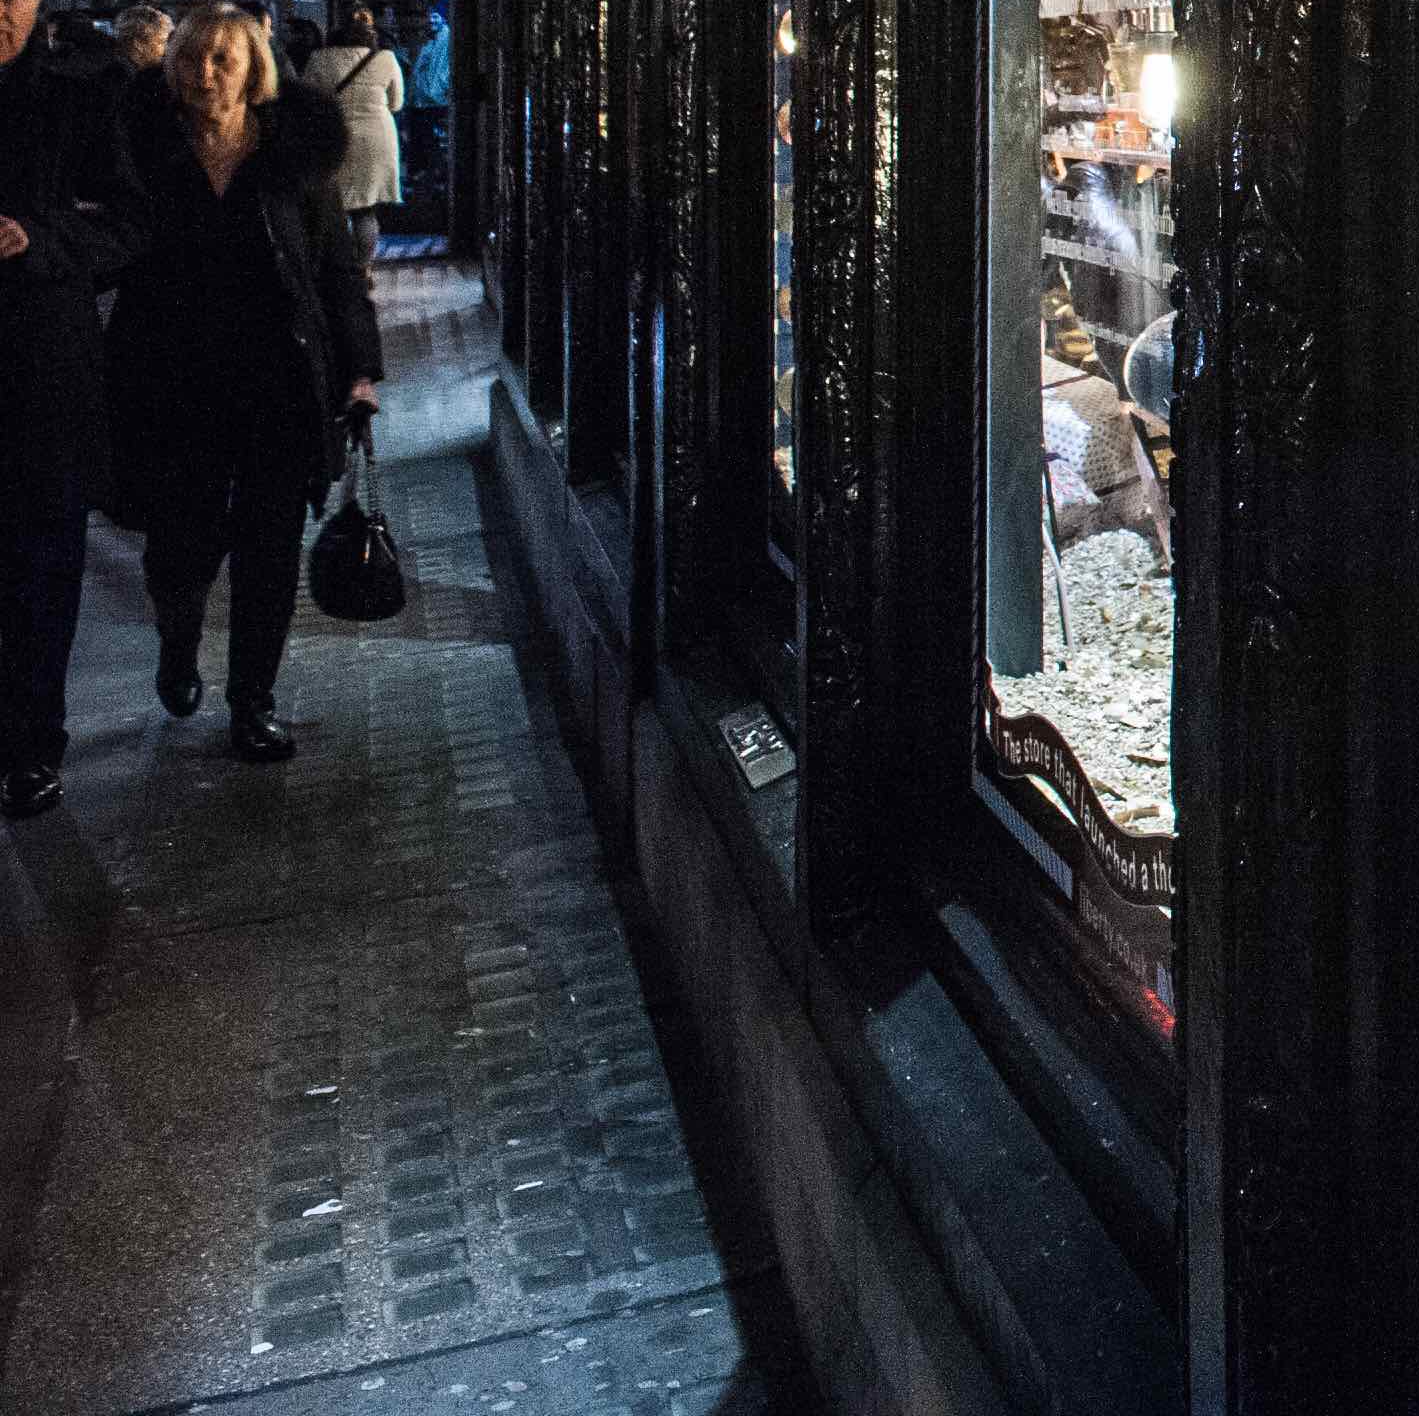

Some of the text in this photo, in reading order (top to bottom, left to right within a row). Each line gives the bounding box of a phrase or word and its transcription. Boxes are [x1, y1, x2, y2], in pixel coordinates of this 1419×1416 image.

[1003, 731, 1022, 766] The
[1024, 733, 1051, 771] store
[1054, 749, 1077, 807] that
[1079, 784, 1137, 891] launched
[1140, 861, 1149, 892] a
